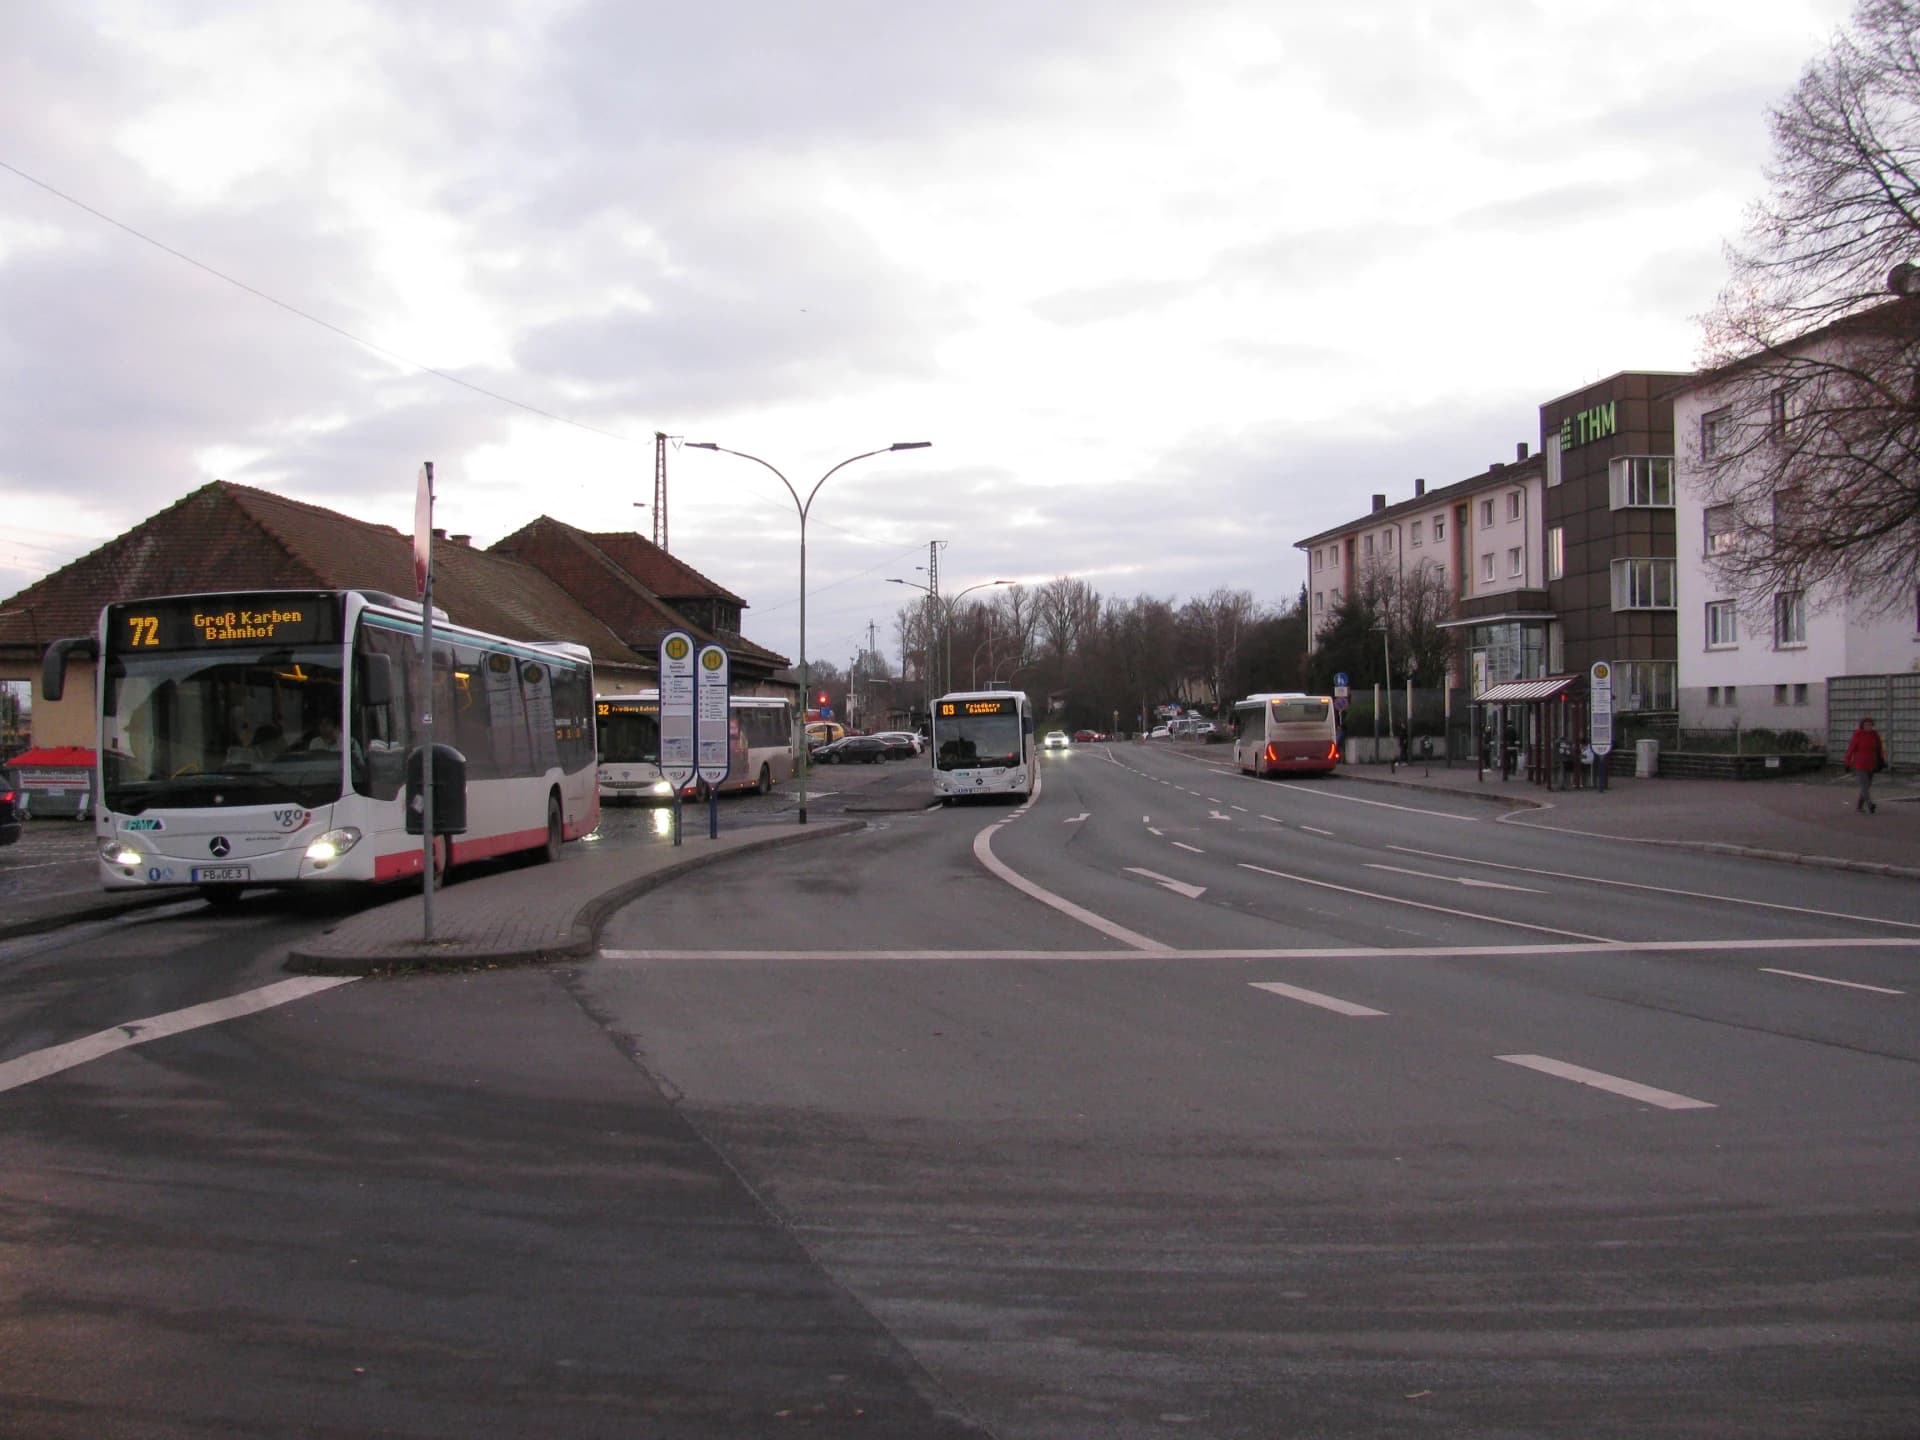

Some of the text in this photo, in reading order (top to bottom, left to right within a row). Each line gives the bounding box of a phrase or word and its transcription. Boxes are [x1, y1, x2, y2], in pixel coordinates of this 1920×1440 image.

[1577, 400, 1615, 445] THM
[193, 610, 302, 627] Groß Karben
[129, 616, 160, 646] 72
[205, 624, 275, 640] Bahnhof
[598, 704, 610, 716] 32
[273, 809, 303, 827] vgo
